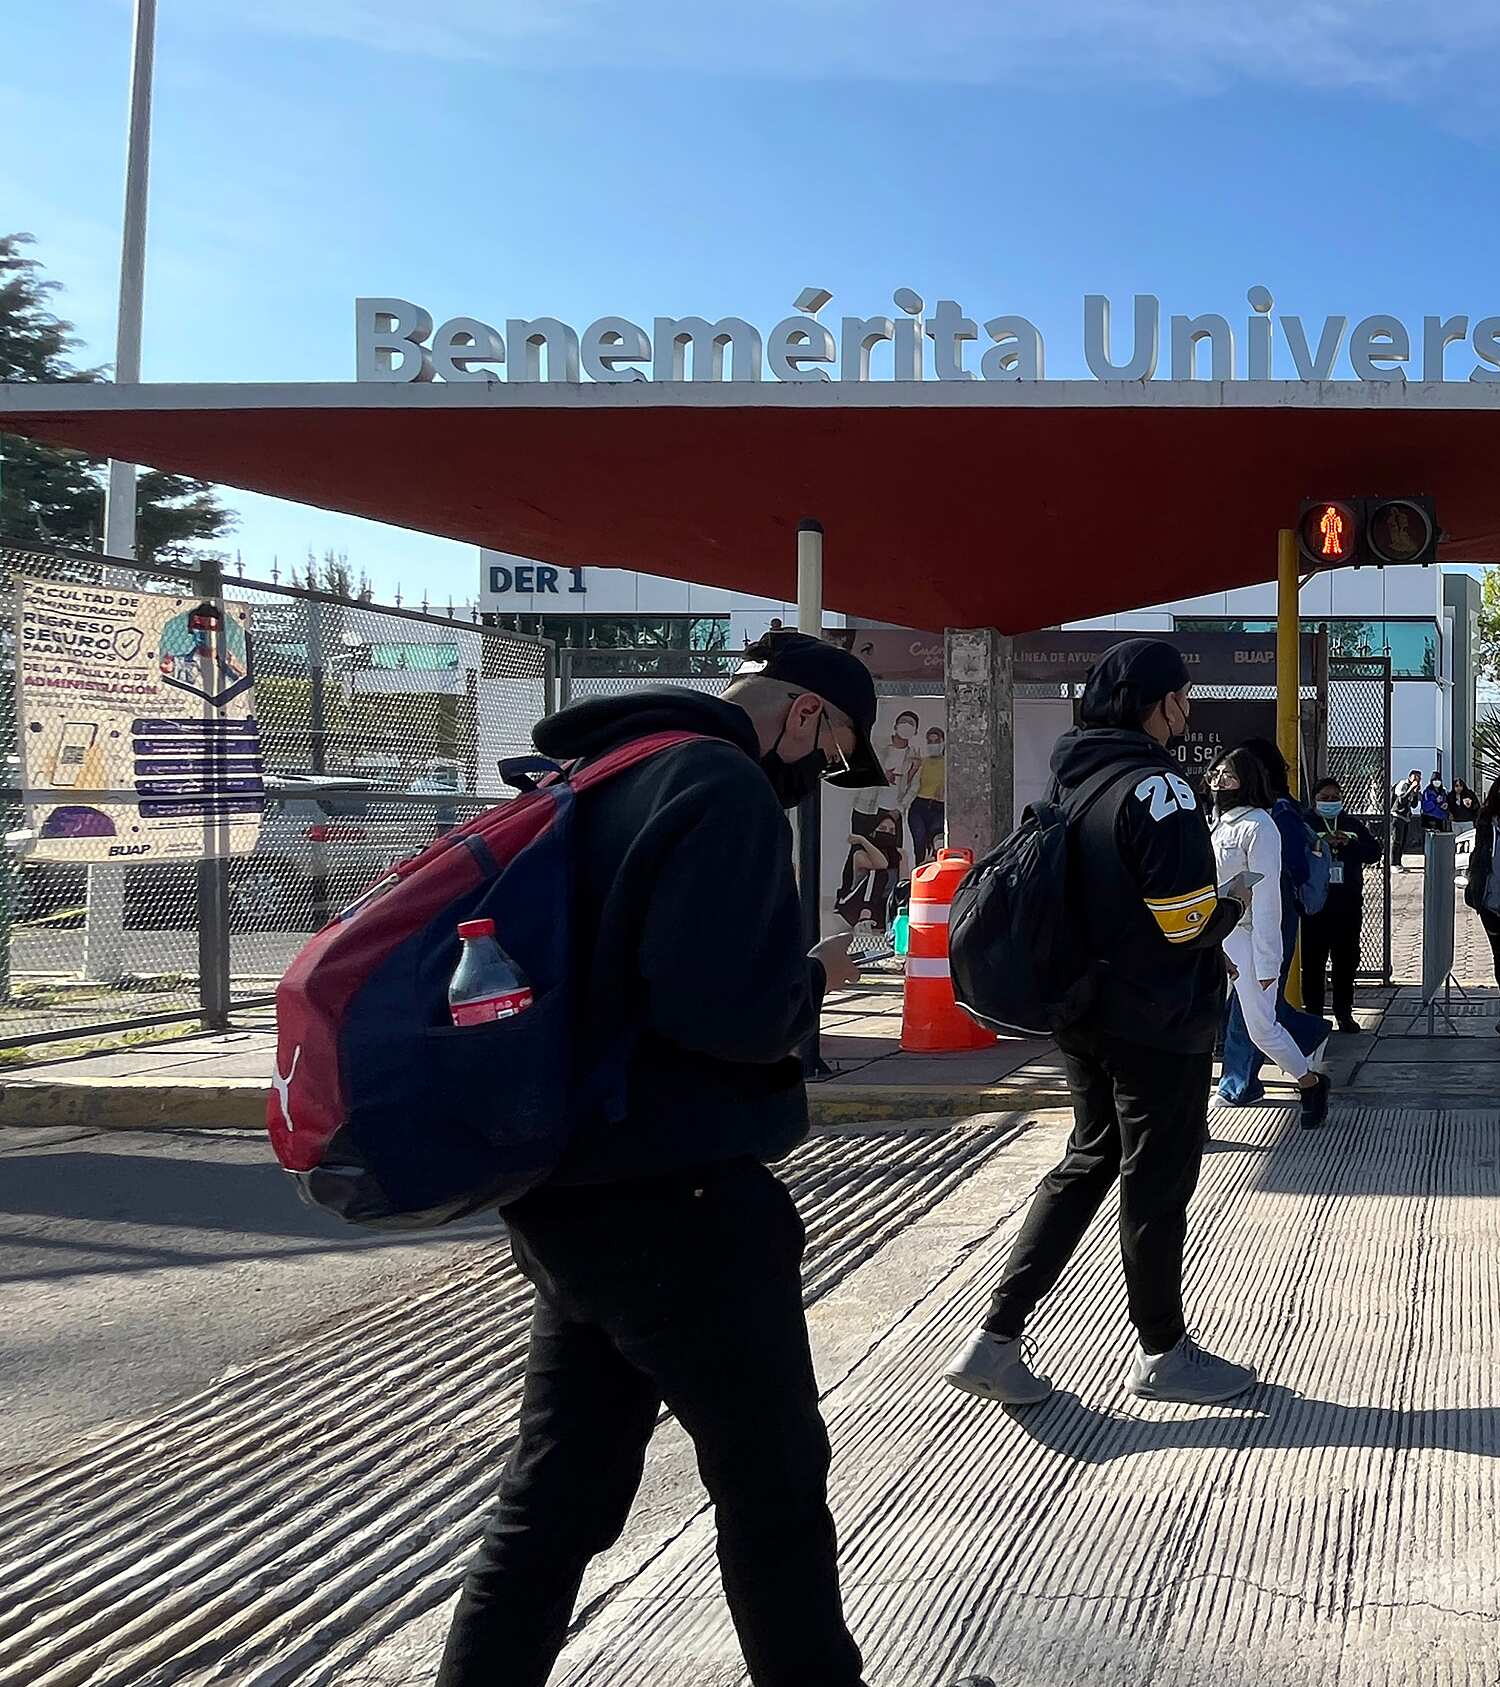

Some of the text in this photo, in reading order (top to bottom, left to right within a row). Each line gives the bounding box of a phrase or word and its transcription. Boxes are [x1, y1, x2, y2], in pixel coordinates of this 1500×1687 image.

[355, 287, 1046, 383] Benemérita
[489, 566, 588, 594] DER 1
[118, 597, 139, 608] DE
[24, 612, 114, 634] REGRESO
[23, 628, 112, 650] SEGURO
[23, 642, 64, 654] PARA
[65, 647, 116, 661] TODOS
[1050, 652, 1066, 663] DE
[1067, 652, 1100, 663] AYUD
[1135, 772, 1197, 822] 26
[109, 844, 151, 856] BUAP
